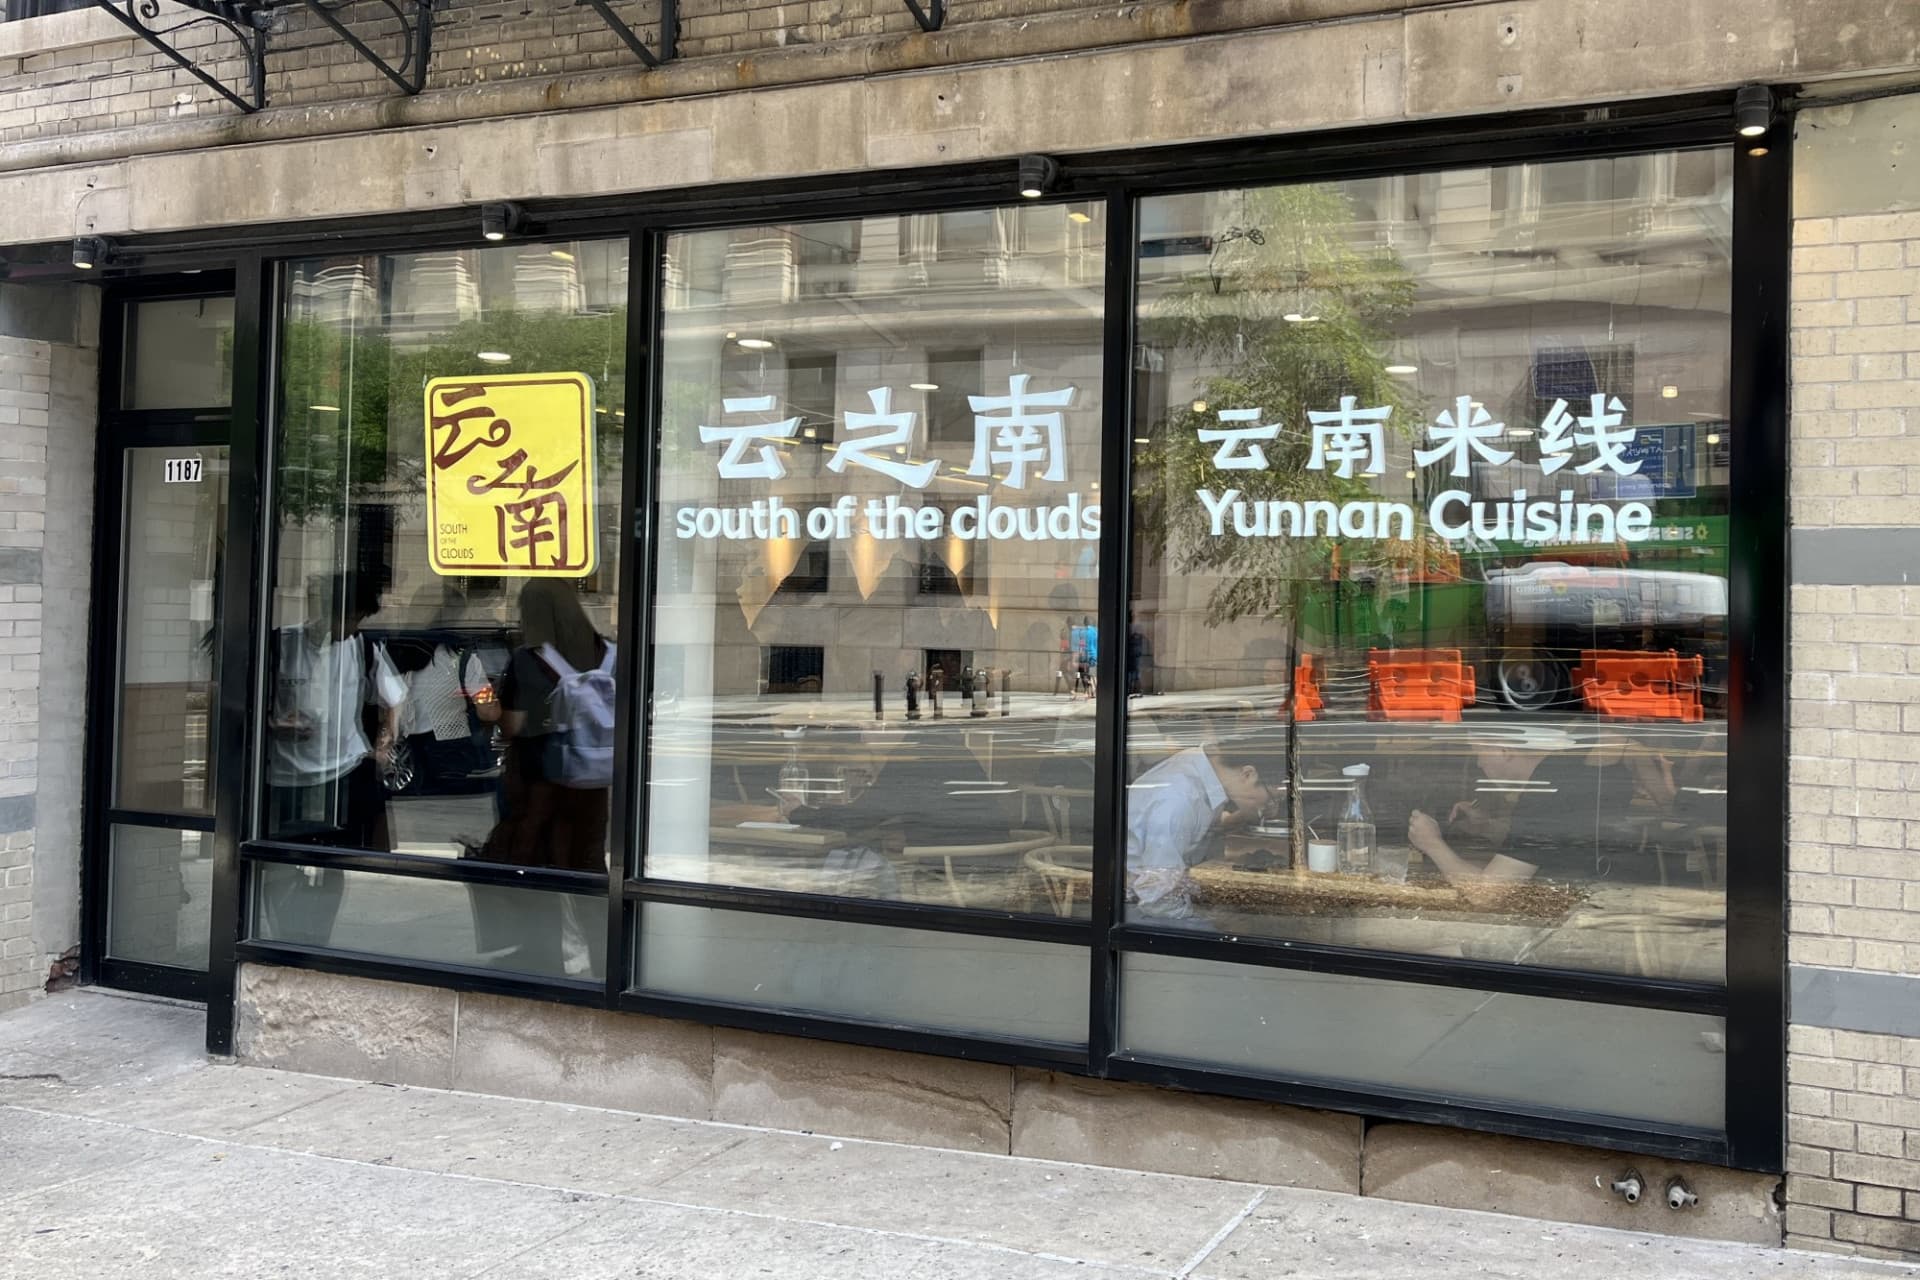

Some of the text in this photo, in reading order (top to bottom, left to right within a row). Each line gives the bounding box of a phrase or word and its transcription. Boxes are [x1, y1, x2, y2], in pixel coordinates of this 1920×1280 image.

[698, 373, 1077, 490] 云之南
[1197, 392, 1643, 479] 云南米线
[167, 460, 201, 481] 1187
[440, 523, 468, 535] SOUTH
[676, 492, 1101, 541] south of the clouds
[1196, 489, 1414, 541] Yunnan
[1429, 488, 1652, 543] Cuisine
[440, 547, 474, 559] CLOUDS
